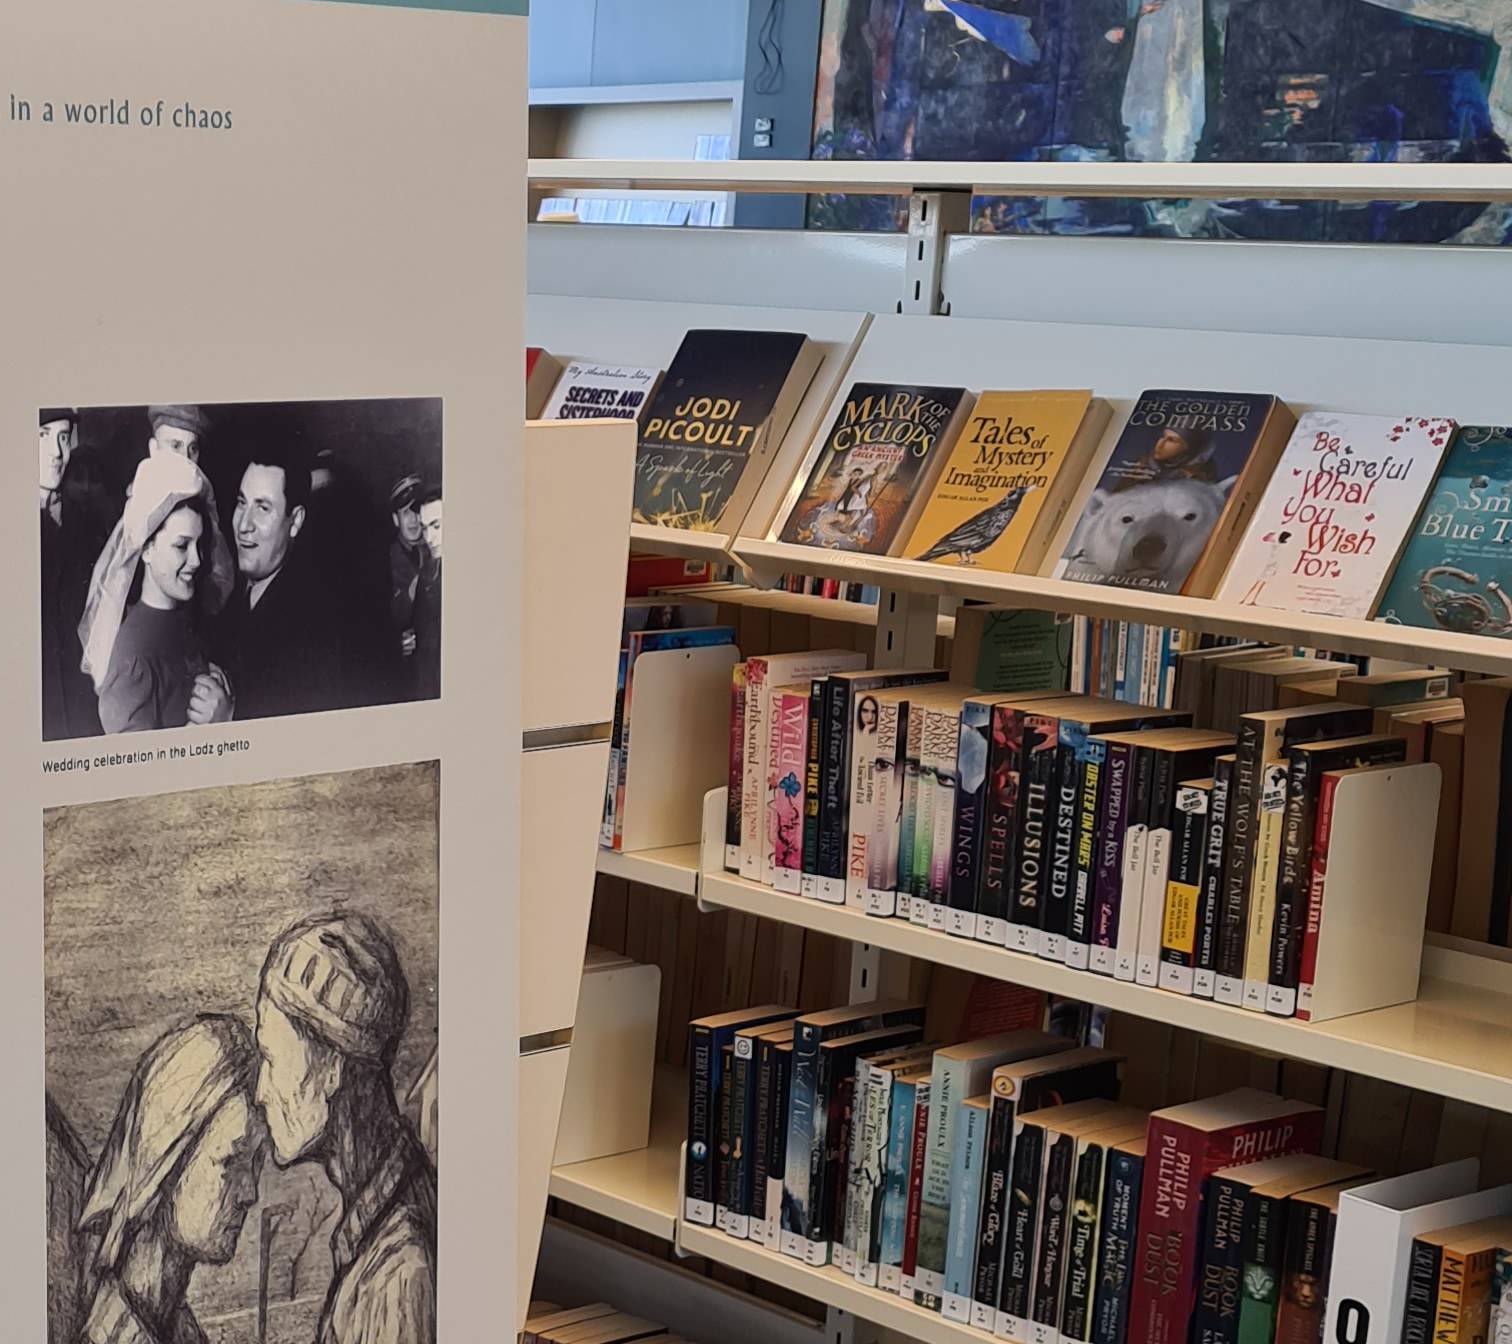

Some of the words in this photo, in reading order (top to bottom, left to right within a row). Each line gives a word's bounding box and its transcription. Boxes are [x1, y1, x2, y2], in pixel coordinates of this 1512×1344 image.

[10, 94, 31, 121] in
[42, 101, 54, 123] a
[65, 98, 129, 125] world
[140, 100, 163, 127] of
[172, 101, 232, 129] chaos
[565, 385, 619, 406] SECRETS
[616, 389, 646, 408] AND
[675, 396, 742, 421] JODI
[840, 392, 932, 429] MARK
[929, 403, 952, 419] OF
[1137, 399, 1170, 412] THE
[1174, 402, 1252, 418] GOLDEN
[644, 418, 754, 448] PICOULT
[832, 421, 937, 458] CYCLOPS
[920, 411, 942, 433] THE
[970, 416, 1036, 446] Tales
[1030, 434, 1050, 449] of
[1129, 411, 1250, 433] COMPASS
[973, 444, 1054, 472] Mystery
[1313, 431, 1340, 453] Be
[944, 467, 1049, 494] Imagination
[1319, 452, 1414, 482] Careful
[1299, 469, 1378, 506] What
[1307, 522, 1377, 555] Wish
[1420, 512, 1486, 541] Blue
[781, 702, 804, 767] Wild
[42, 757, 91, 773] Wedding
[93, 750, 154, 768] celebration
[156, 747, 167, 760] in
[169, 744, 186, 759] the
[189, 740, 214, 757] Lodz
[216, 738, 250, 756] ghetto
[1108, 758, 1126, 819] SWAPPED
[849, 833, 866, 879] PIKE
[955, 806, 976, 878] WINGS
[986, 814, 1008, 890] SPELLS
[1018, 782, 1046, 909] ILLUSIONS
[1051, 786, 1076, 899] DESTINED
[1104, 839, 1119, 869] KISS
[1231, 1125, 1294, 1159] PHILIP
[1154, 1134, 1177, 1218] PULLMAN
[1177, 1151, 1191, 1211] PHILIP
[1213, 1185, 1233, 1250] PULLMAN
[1230, 1197, 1246, 1244] PHILIP
[1436, 1256, 1465, 1342] MATTHEW
